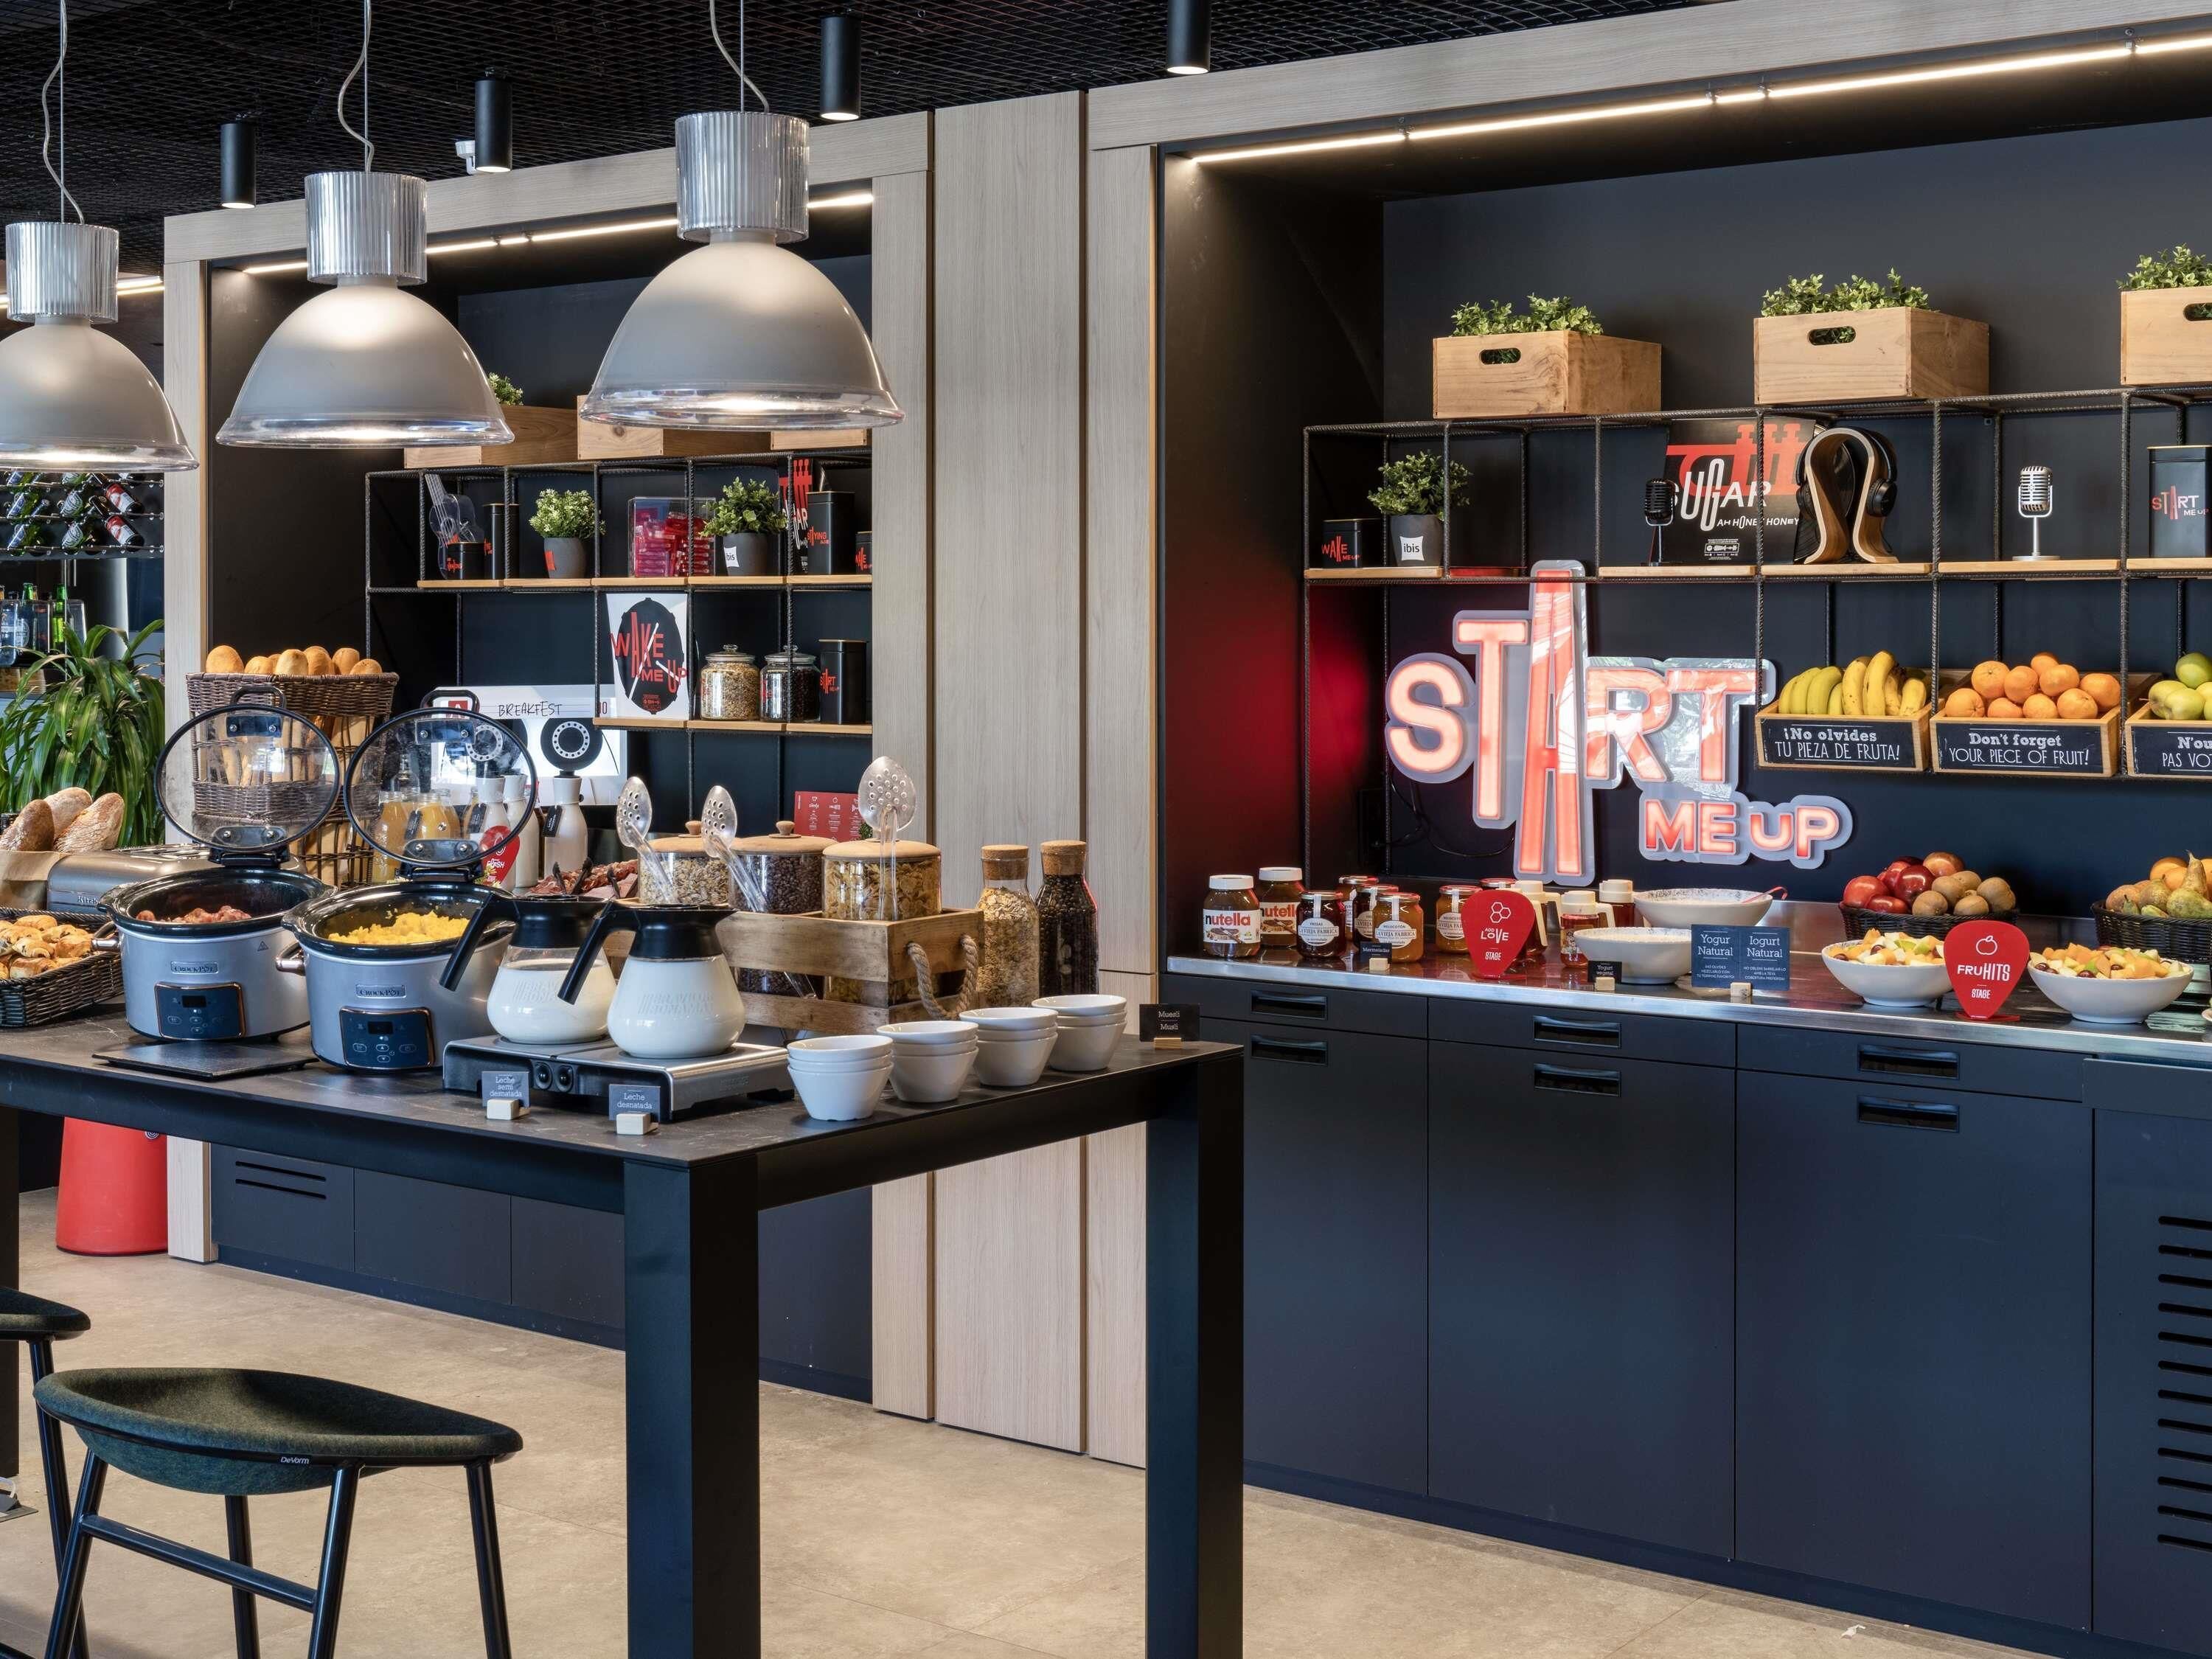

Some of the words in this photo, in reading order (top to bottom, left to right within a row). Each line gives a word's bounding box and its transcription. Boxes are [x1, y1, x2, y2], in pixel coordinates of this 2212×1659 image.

[2152, 485, 2199, 520] START
[1732, 515, 1764, 529] HONE
[1321, 536, 1349, 562] WAKE
[1403, 543, 1420, 553] ibis
[610, 611, 664, 678] WAKE
[641, 669, 664, 682] ME
[667, 660, 687, 693] UP
[498, 701, 563, 717] BREAKFEST
[1388, 569, 1759, 876] START
[1784, 727, 1812, 740] ¡No
[1818, 728, 1877, 742] olvides
[1969, 732, 2008, 745] Don't
[2012, 734, 2062, 750] forget
[2177, 737, 2212, 749] N'ou
[1775, 741, 1792, 757] TU
[1797, 742, 1829, 758] PIEZA
[1835, 742, 1851, 759] DE
[1857, 743, 1900, 760] FRUTA!
[1949, 748, 1986, 762] YOUR
[1990, 748, 2023, 763] PIECE
[2028, 749, 2048, 764] OF
[2053, 749, 2089, 765] FRUIT!
[2162, 752, 2183, 767] PAS
[1644, 799, 1739, 855] ME
[1750, 804, 1841, 860] UP
[1260, 904, 1295, 917] nutell
[1205, 912, 1251, 926] nutella
[1481, 928, 1509, 944] LOVE
[1700, 934, 1731, 945] Yogur
[1749, 936, 1781, 947] Iogurt
[1485, 951, 1502, 961] STAGE
[1697, 946, 1733, 956] Natural
[1746, 947, 1783, 958] Natural
[1957, 962, 2011, 981] FRUHITS
[1971, 988, 1991, 999] STAGE
[495, 1075, 515, 1085] Leche
[489, 1089, 523, 1098] desnatada
[624, 1092, 645, 1101] Leche
[616, 1100, 653, 1110] desnatada
[280, 1456, 310, 1464] DeVorm
